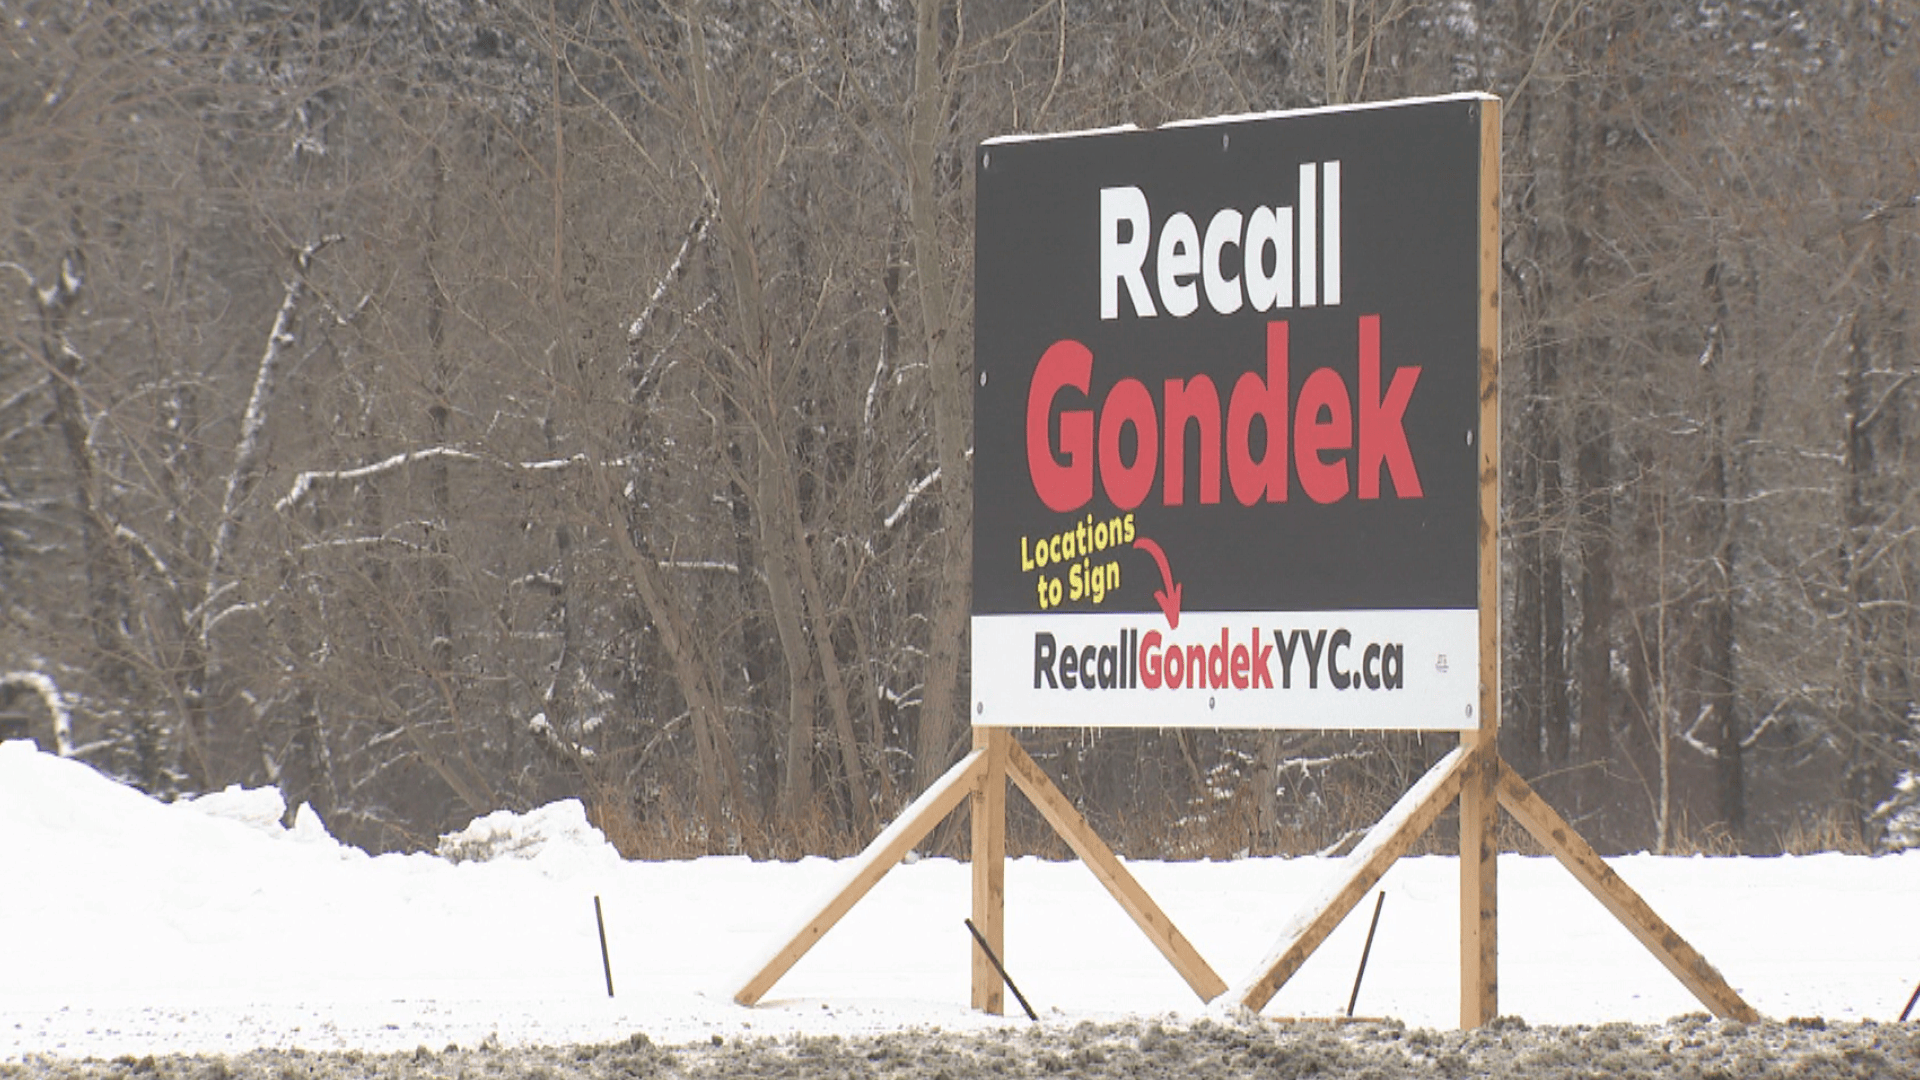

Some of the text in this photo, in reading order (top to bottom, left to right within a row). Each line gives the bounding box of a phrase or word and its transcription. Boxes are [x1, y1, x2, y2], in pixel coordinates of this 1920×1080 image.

[1100, 160, 1341, 320] Recall
[1026, 314, 1424, 512] Gondek
[1020, 513, 1136, 573] Locations
[1037, 559, 1121, 610] to Sign
[1033, 627, 1404, 690] RecallGondekYYC.ca
